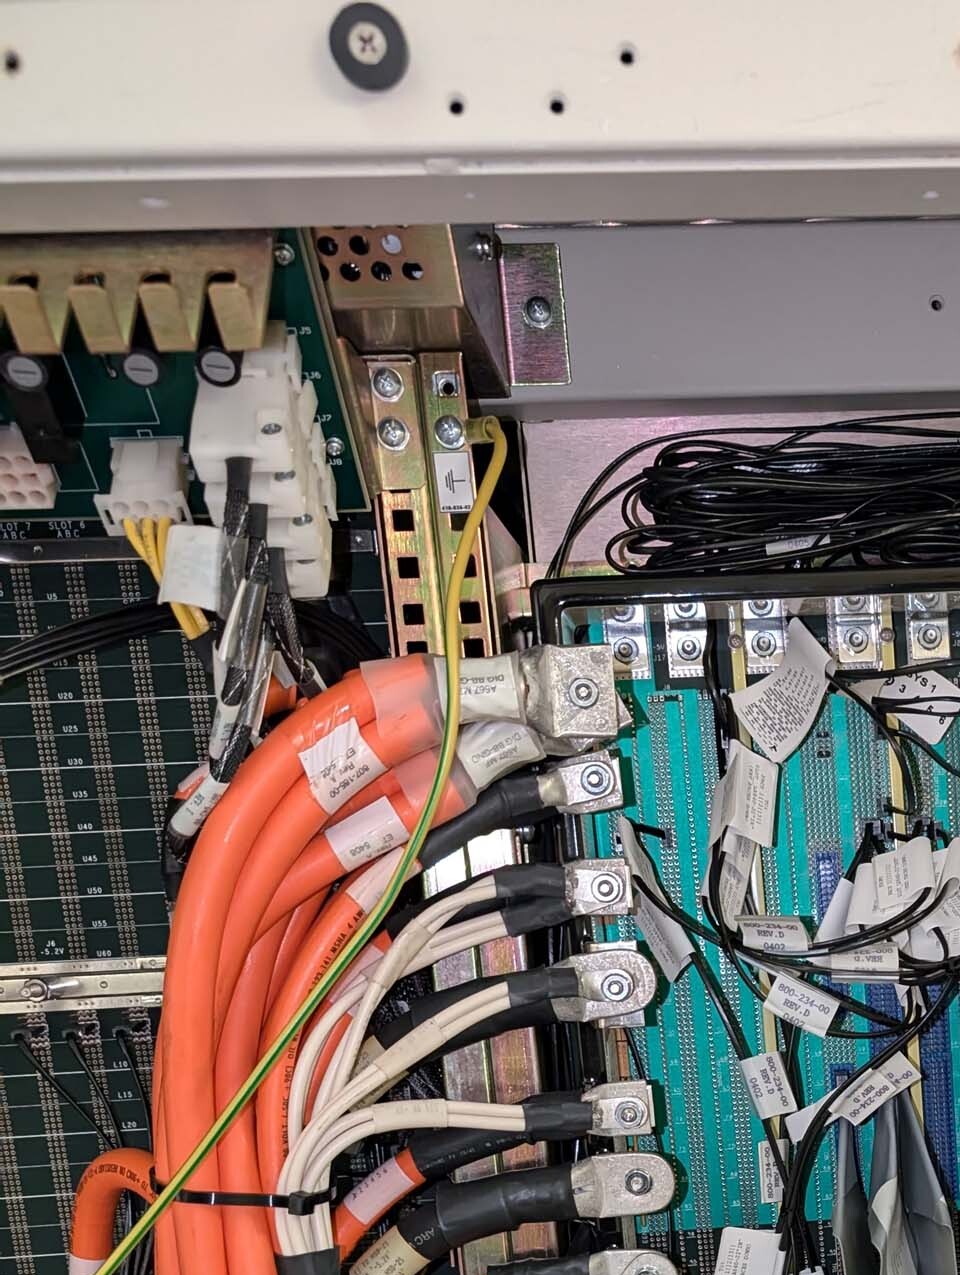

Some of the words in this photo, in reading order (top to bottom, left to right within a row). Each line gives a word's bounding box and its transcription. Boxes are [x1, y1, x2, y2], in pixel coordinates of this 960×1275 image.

[300, 327, 311, 335] J5
[0, 521, 18, 531] LOT
[24, 522, 31, 530] 7
[48, 521, 75, 530] SLOT
[79, 521, 85, 529] 6
[898, 684, 907, 693] 3
[63, 725, 78, 733] U25
[757, 930, 784, 938] REV.D
[778, 984, 830, 1015] 800-234-00
[783, 999, 810, 1017] REV.D
[751, 1077, 763, 1098] 0402
[760, 1069, 774, 1095] REV.D
[767, 1056, 789, 1107] 800-234-00
[850, 1085, 889, 1118] 800-234-00
[764, 1147, 773, 1198] 800-234-00
[415, 1228, 435, 1246] ARC
